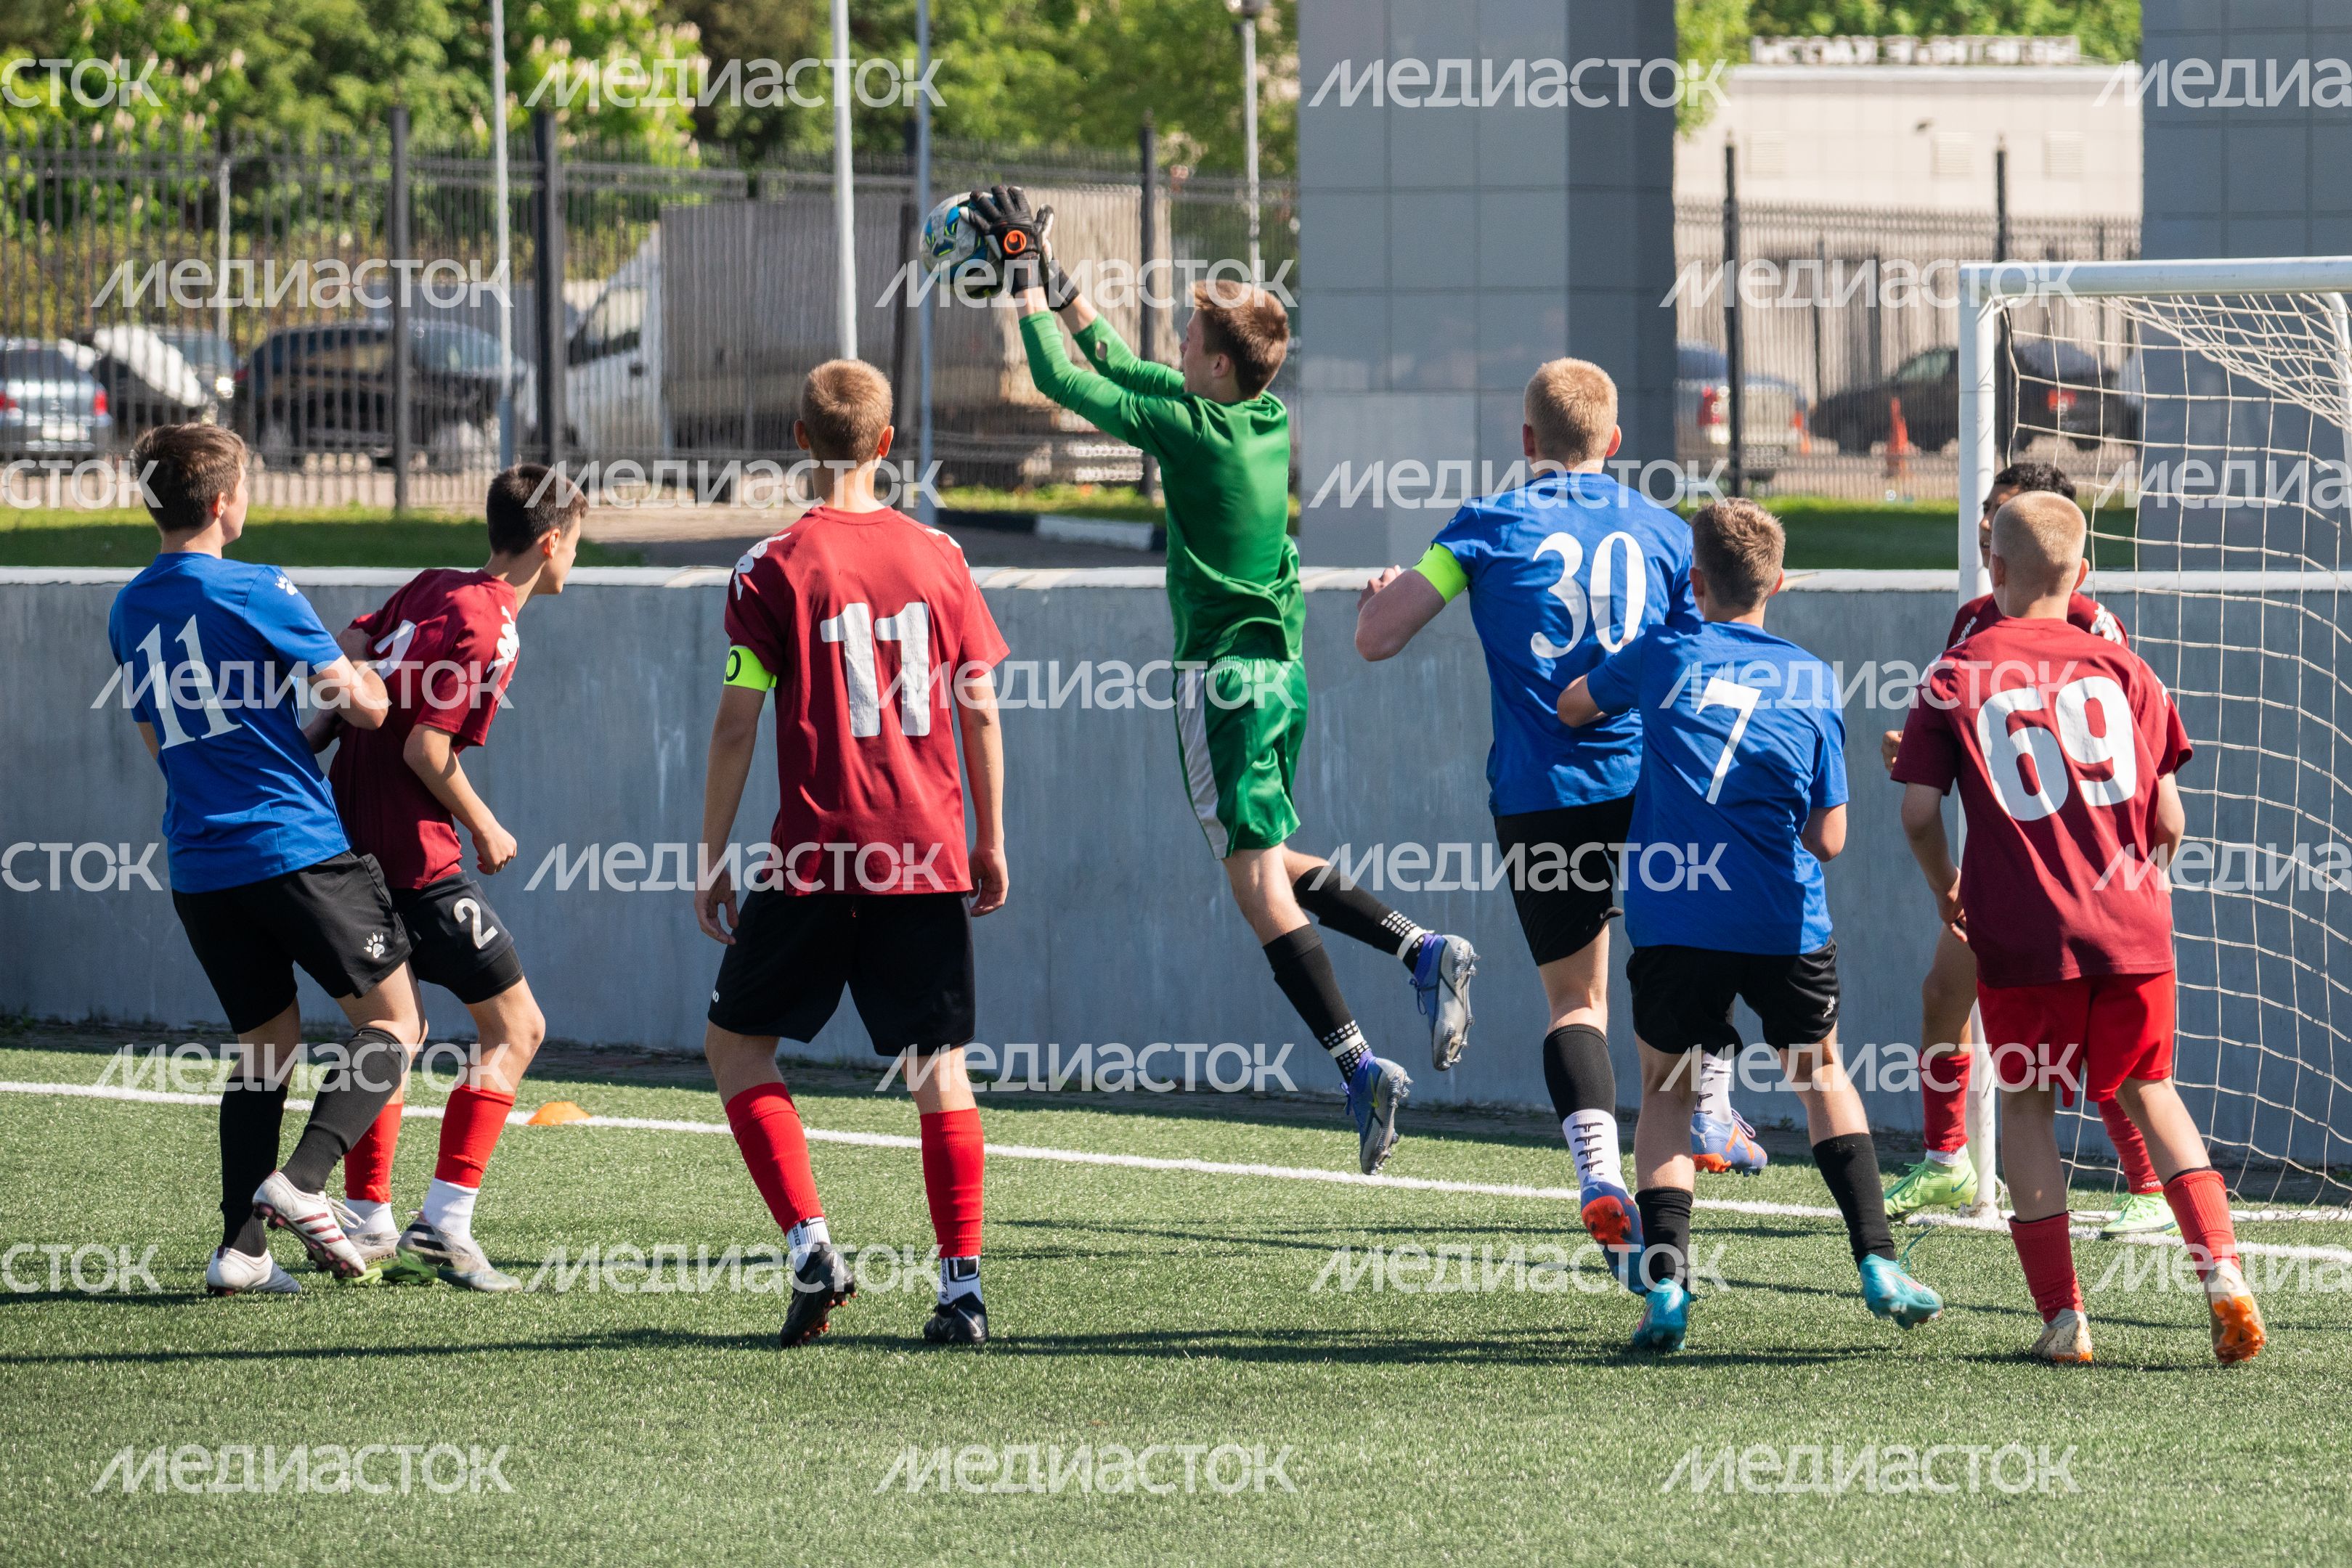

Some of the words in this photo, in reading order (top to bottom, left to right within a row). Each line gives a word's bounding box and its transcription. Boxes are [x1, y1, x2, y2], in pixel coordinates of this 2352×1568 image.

[1530, 531, 1647, 658] 30
[136, 614, 243, 750] 11
[820, 602, 931, 737] 11
[1696, 677, 1762, 805] 7
[1977, 676, 2137, 821] 69
[454, 897, 498, 950] 2
